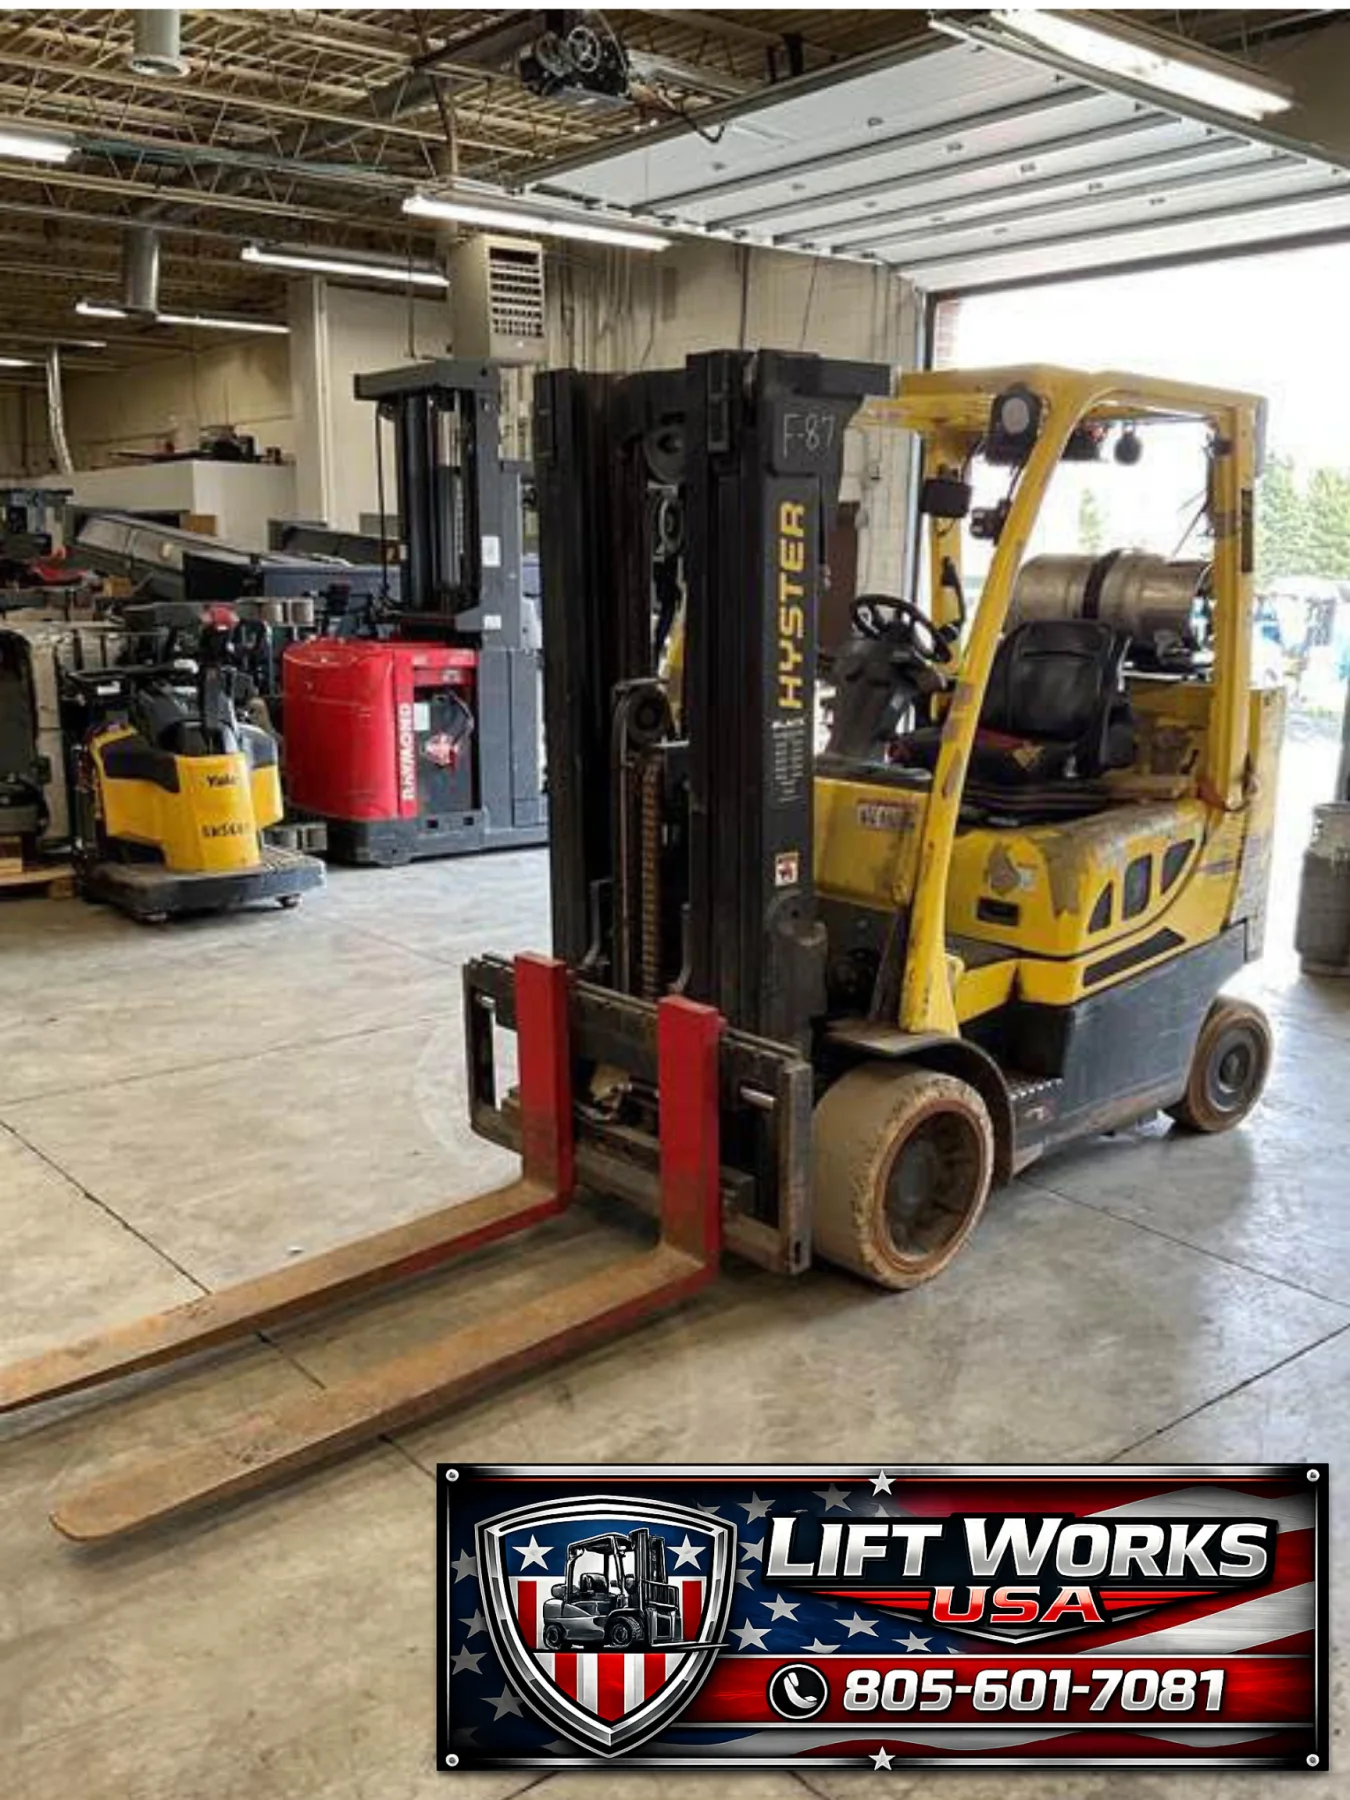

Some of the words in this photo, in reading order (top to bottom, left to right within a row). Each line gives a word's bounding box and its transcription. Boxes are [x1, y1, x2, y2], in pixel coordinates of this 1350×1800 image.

[783, 413, 836, 458] F-87
[778, 501, 805, 709] HYSTER
[397, 702, 416, 800] RAYMOND
